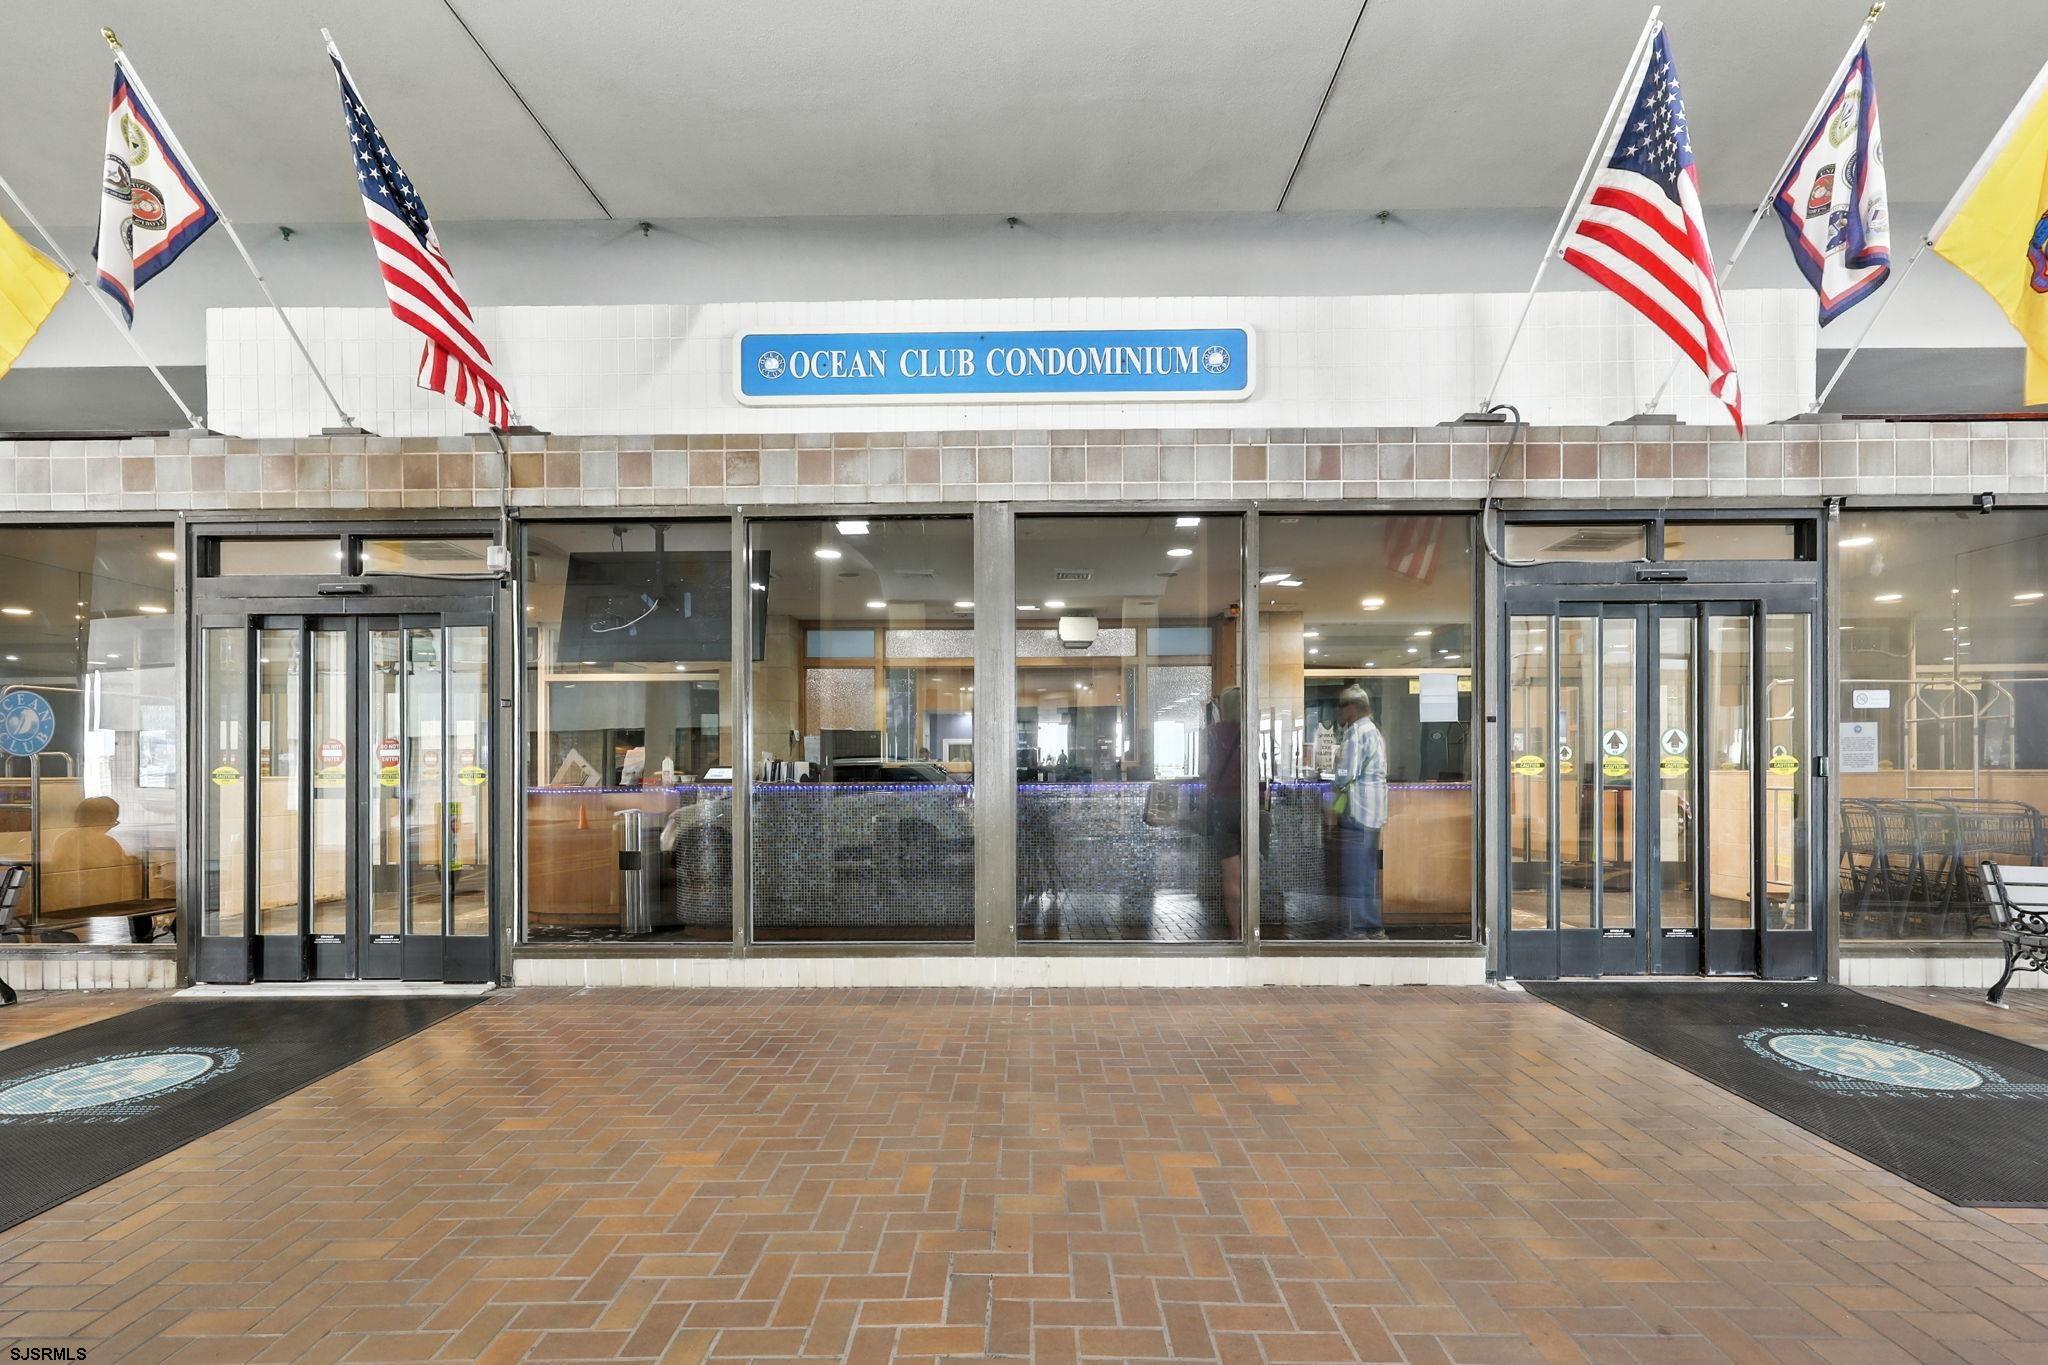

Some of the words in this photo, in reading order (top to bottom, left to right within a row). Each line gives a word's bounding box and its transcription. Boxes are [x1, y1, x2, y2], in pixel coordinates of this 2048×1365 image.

[789, 349, 888, 379] OCEAN
[899, 348, 976, 378] CLUB
[986, 345, 1200, 376] CONDOMINIUM
[0, 732, 48, 753] CLUB
